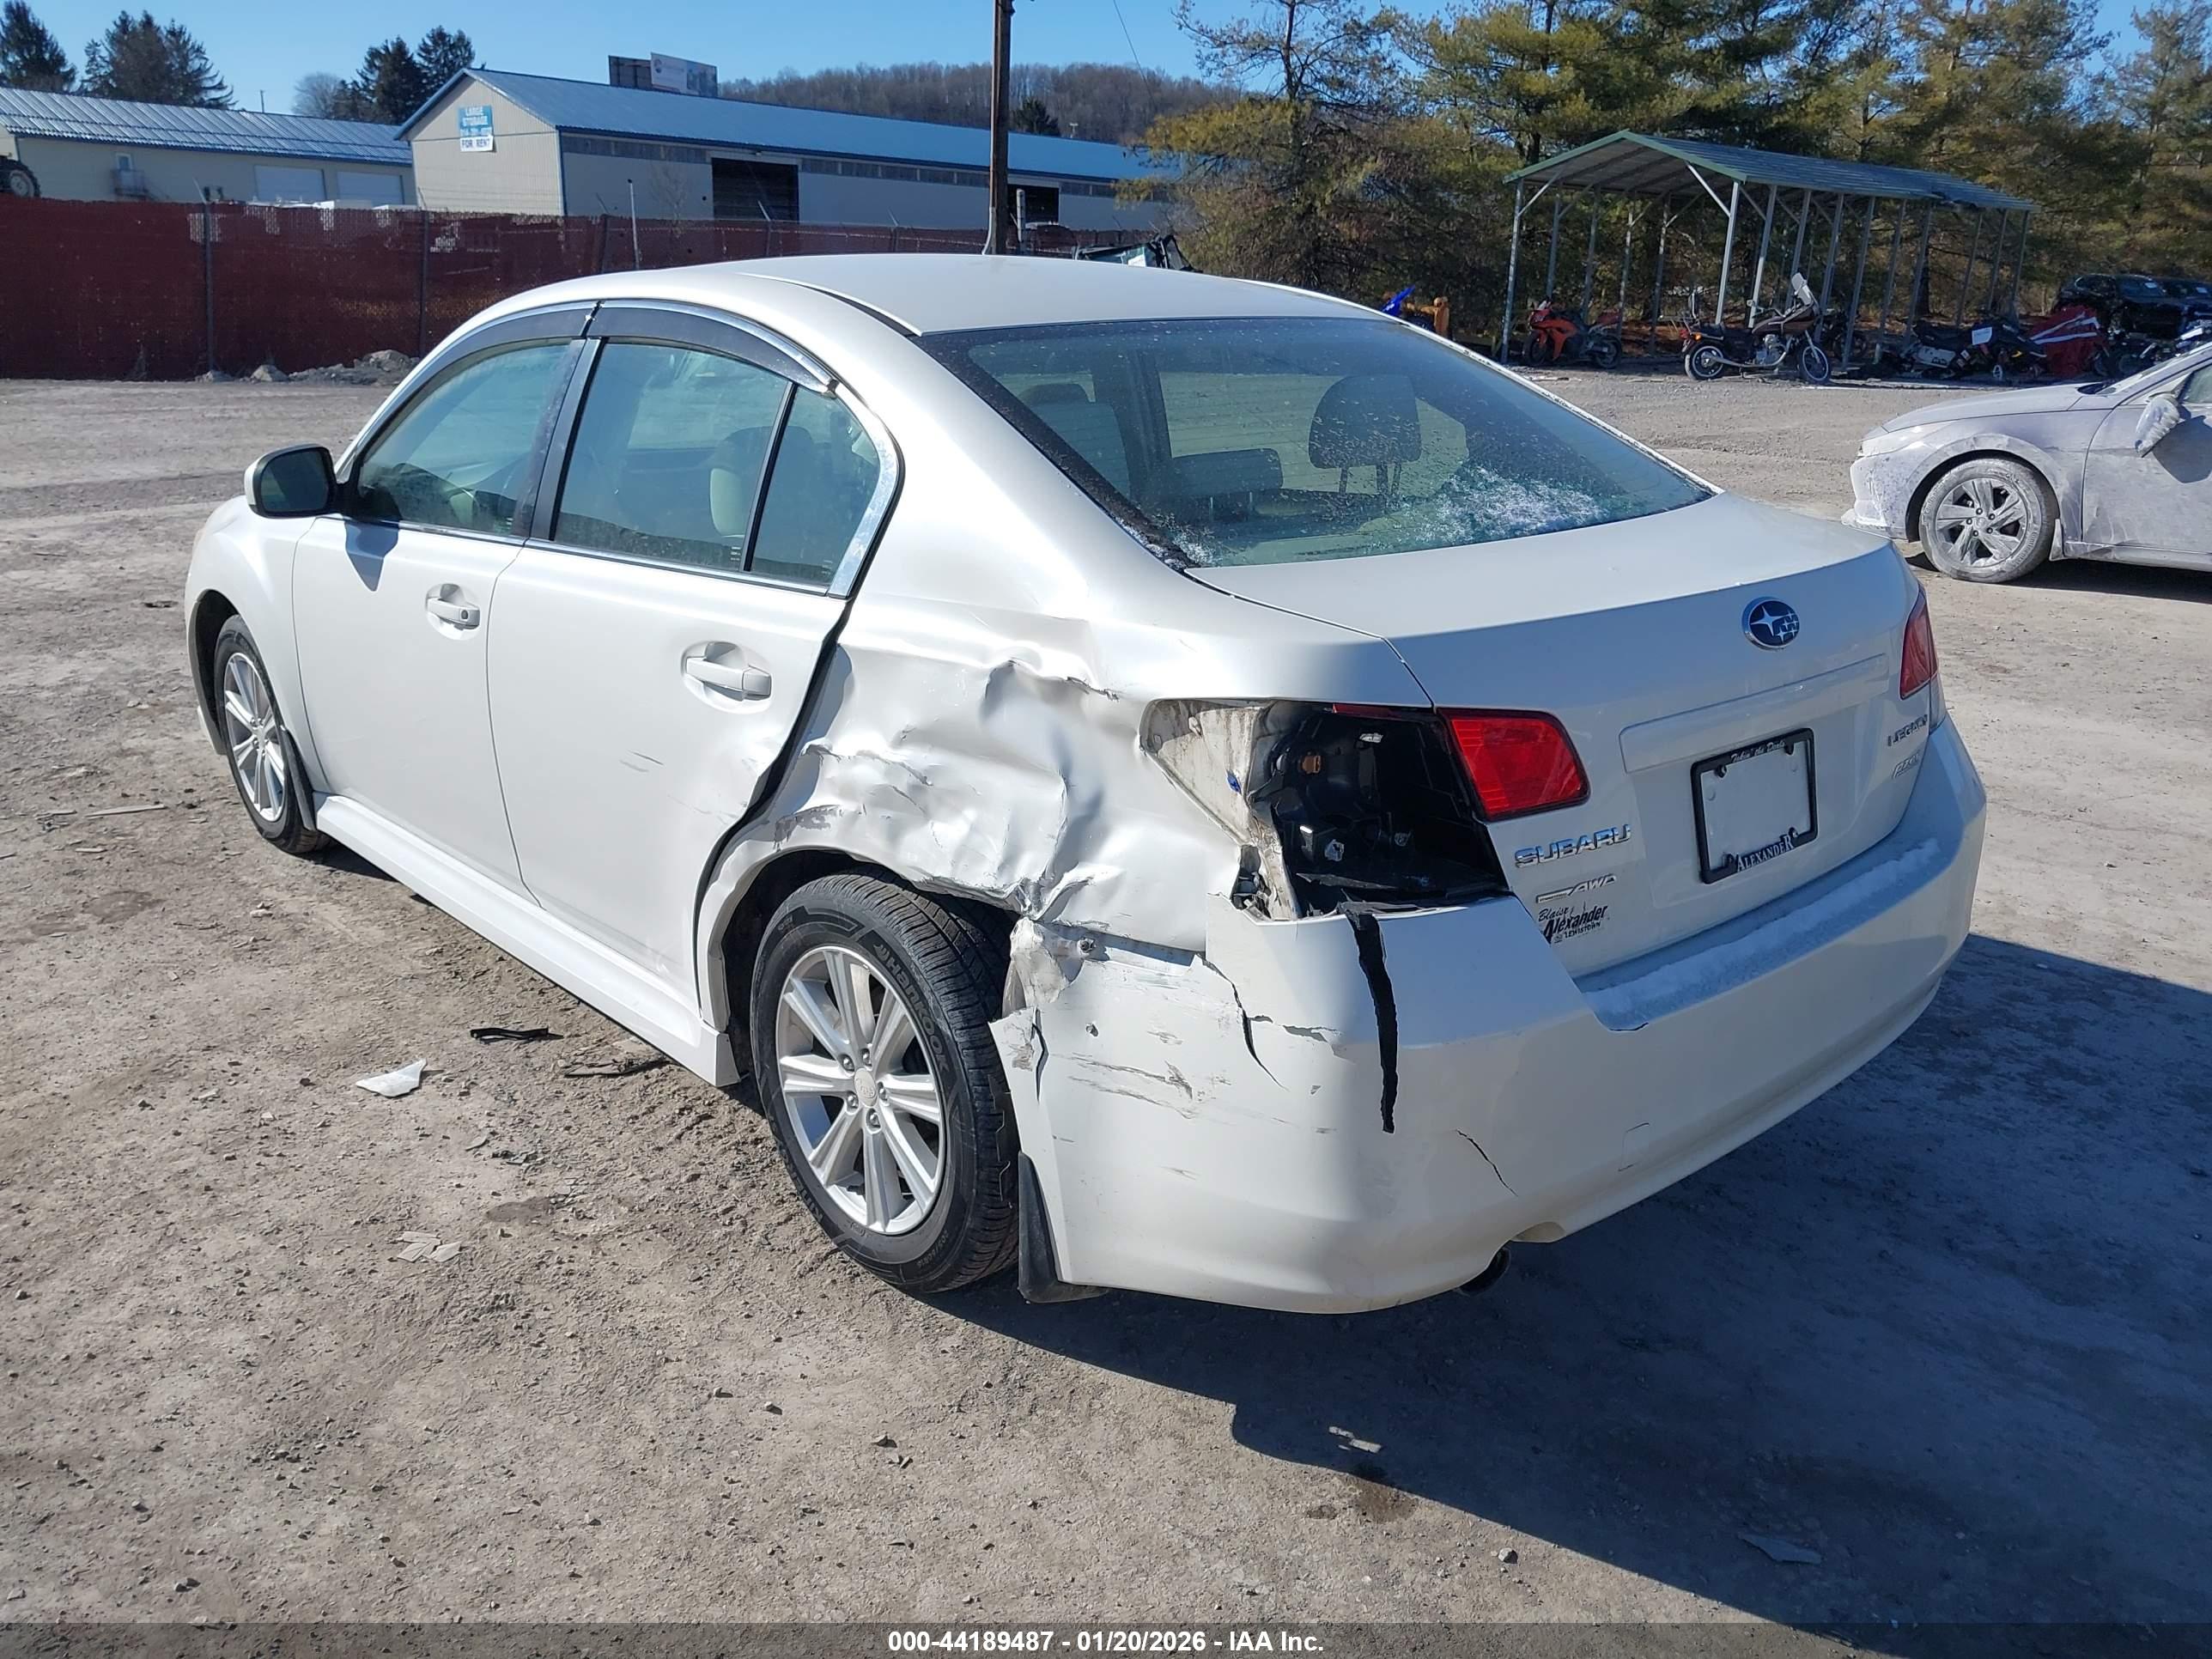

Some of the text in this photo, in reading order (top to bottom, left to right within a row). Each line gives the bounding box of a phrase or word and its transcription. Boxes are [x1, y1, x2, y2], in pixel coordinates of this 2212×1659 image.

[461, 138, 490, 148] FOR RENT
[1515, 823, 1631, 868] SUBARU
[1735, 834, 1795, 872] ALEXANDER
[1568, 872, 1617, 896] AWD
[1543, 905, 1608, 944] Alexander
